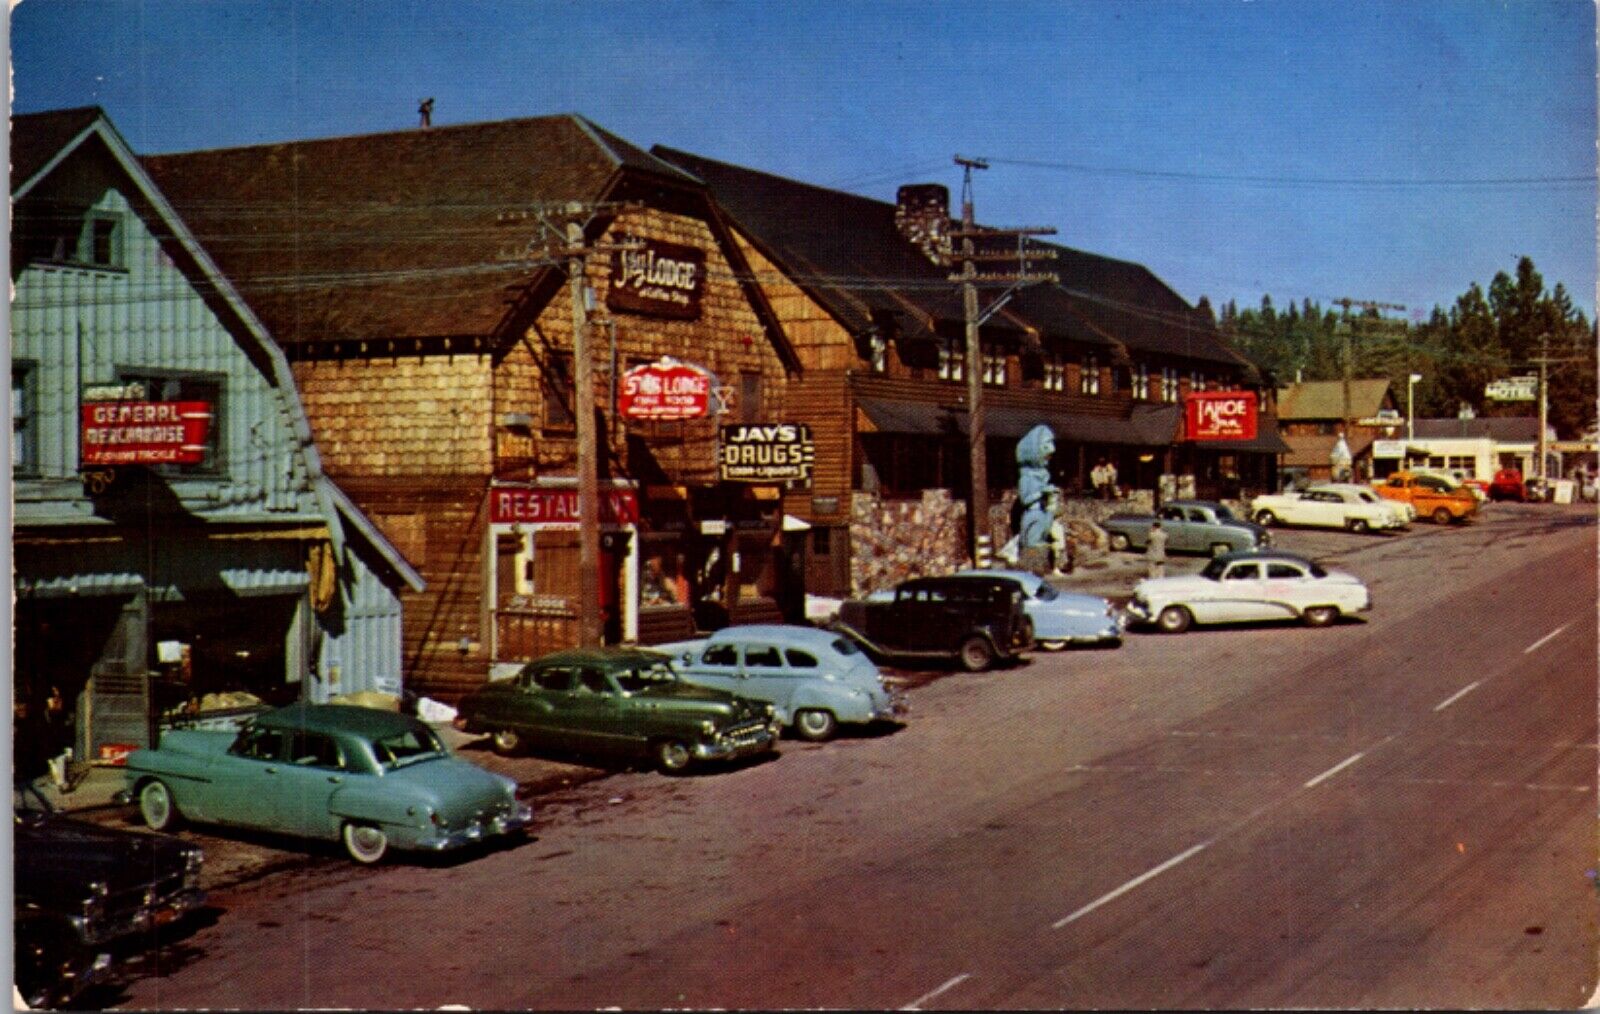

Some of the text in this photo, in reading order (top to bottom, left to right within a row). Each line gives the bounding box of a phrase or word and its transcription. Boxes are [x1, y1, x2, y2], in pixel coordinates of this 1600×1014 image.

[646, 249, 697, 291] LODGE
[662, 375, 707, 395] LODGE
[93, 404, 182, 423] GENERAL
[1195, 400, 1247, 425] TAHOE
[86, 425, 186, 444] MERCHANDISE
[725, 444, 802, 465] DRUGS
